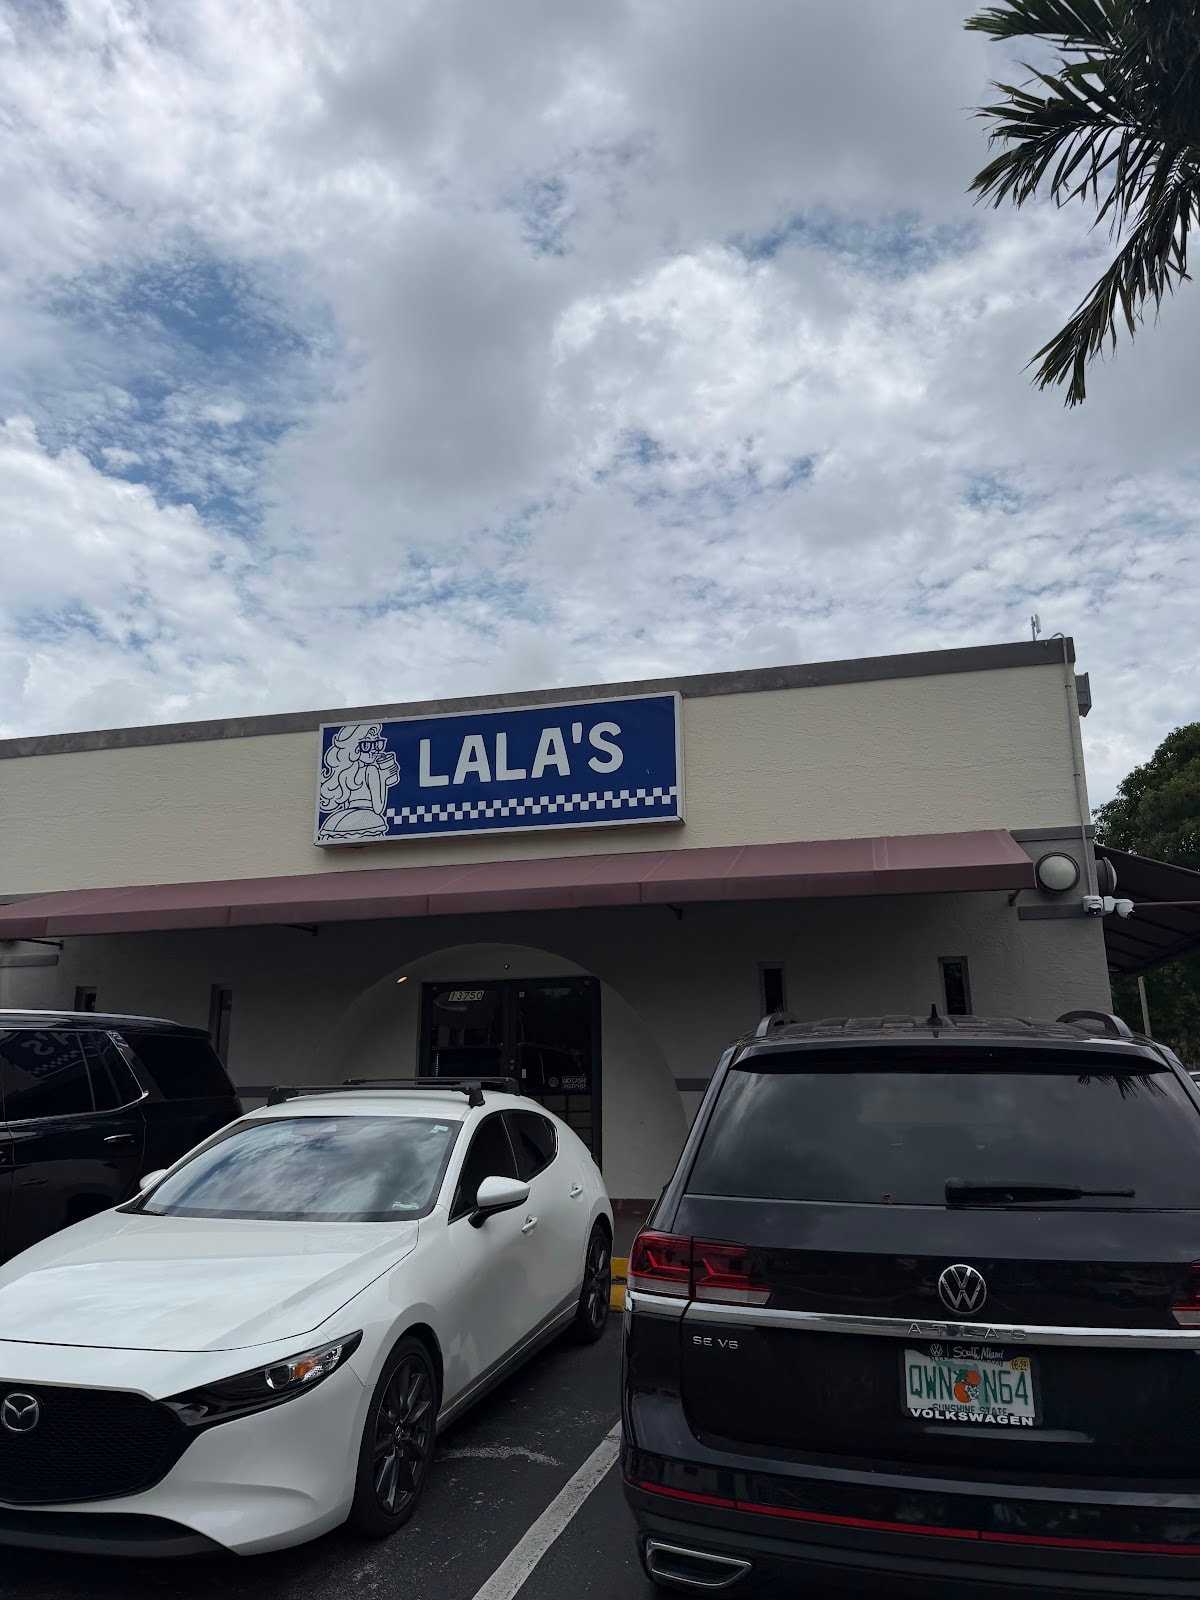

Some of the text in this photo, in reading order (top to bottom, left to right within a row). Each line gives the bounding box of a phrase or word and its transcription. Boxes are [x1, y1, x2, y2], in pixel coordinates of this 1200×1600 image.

[419, 721, 624, 788] LALA'S
[451, 991, 483, 1000] 13750
[908, 1322, 1026, 1340] ATLAS
[693, 1336, 738, 1349] SE V6
[952, 1346, 980, 1360] South
[932, 1403, 1007, 1416] SUNSHINE STATE
[910, 1408, 1034, 1427] VOLKSWAGEN
